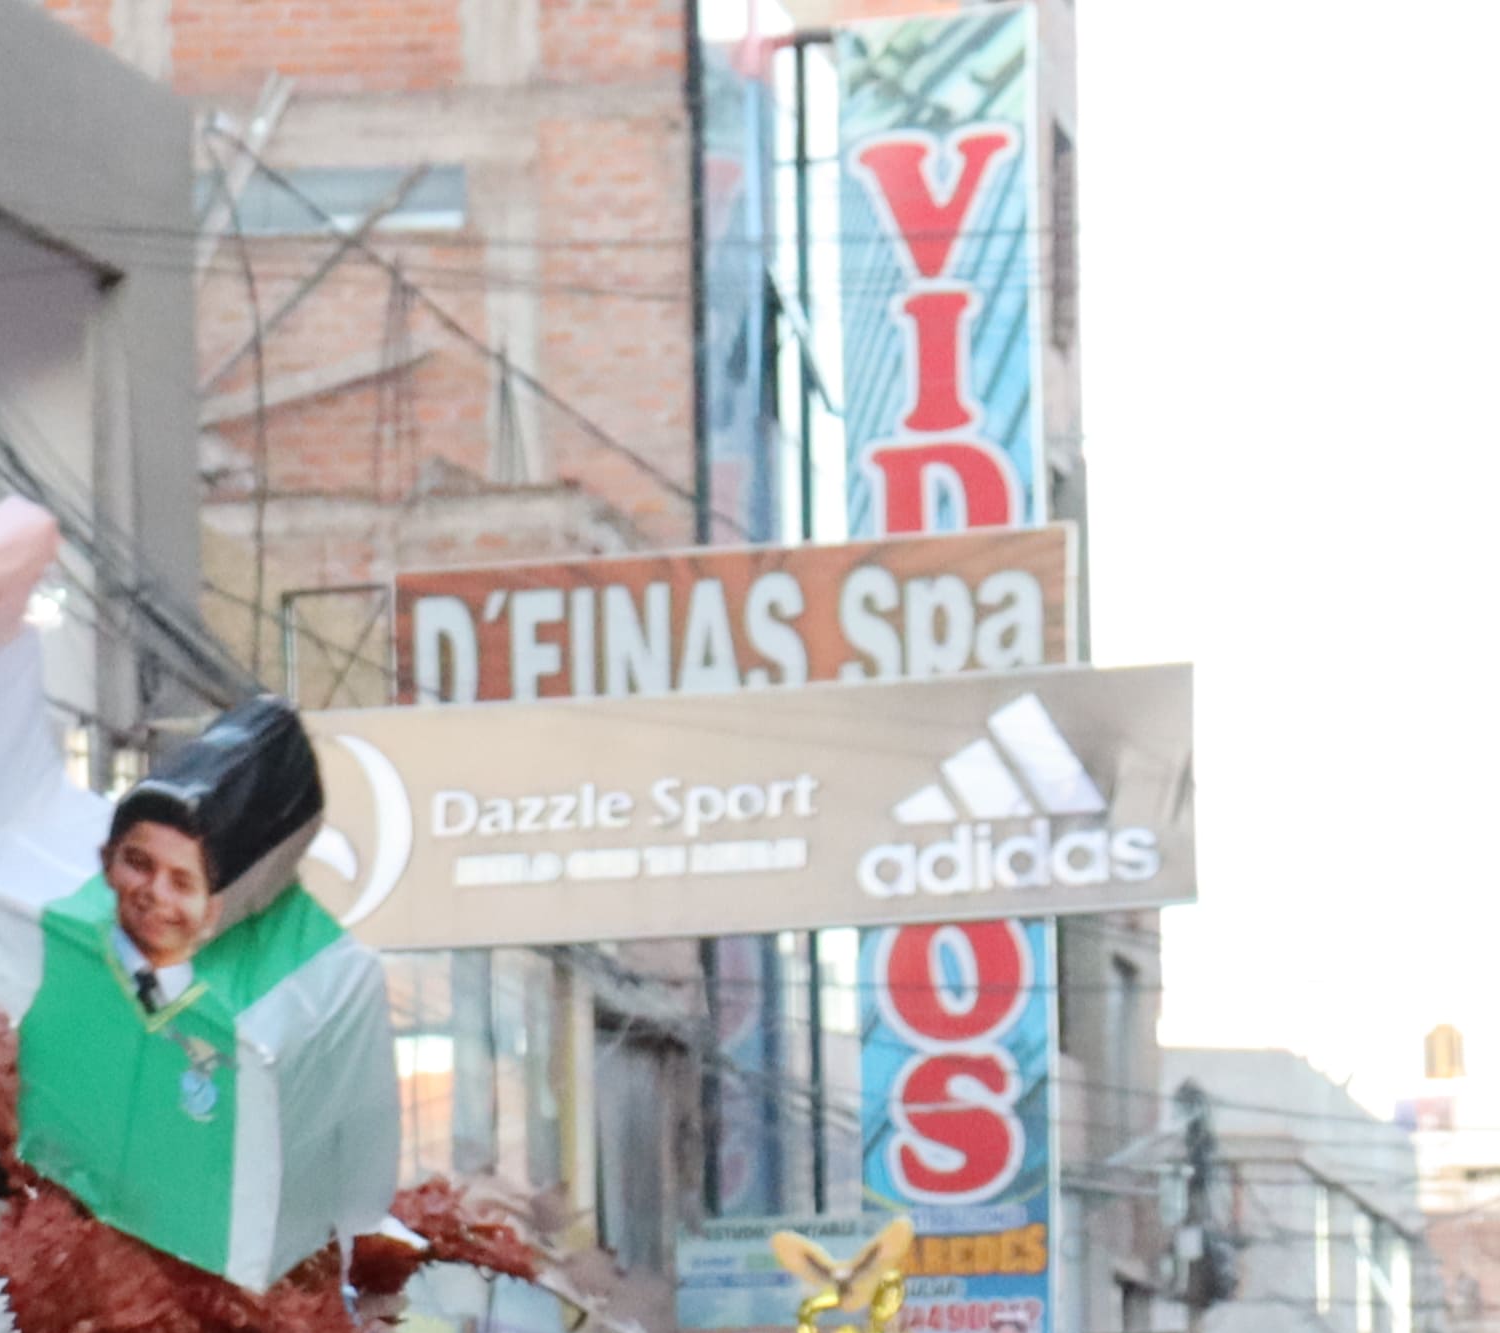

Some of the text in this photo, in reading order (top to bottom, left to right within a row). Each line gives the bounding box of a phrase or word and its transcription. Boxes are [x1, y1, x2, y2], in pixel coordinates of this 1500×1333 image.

[837, 563, 1046, 685] Spa
[431, 773, 819, 838] Dazzle Sport
[857, 818, 1163, 902] adidas
